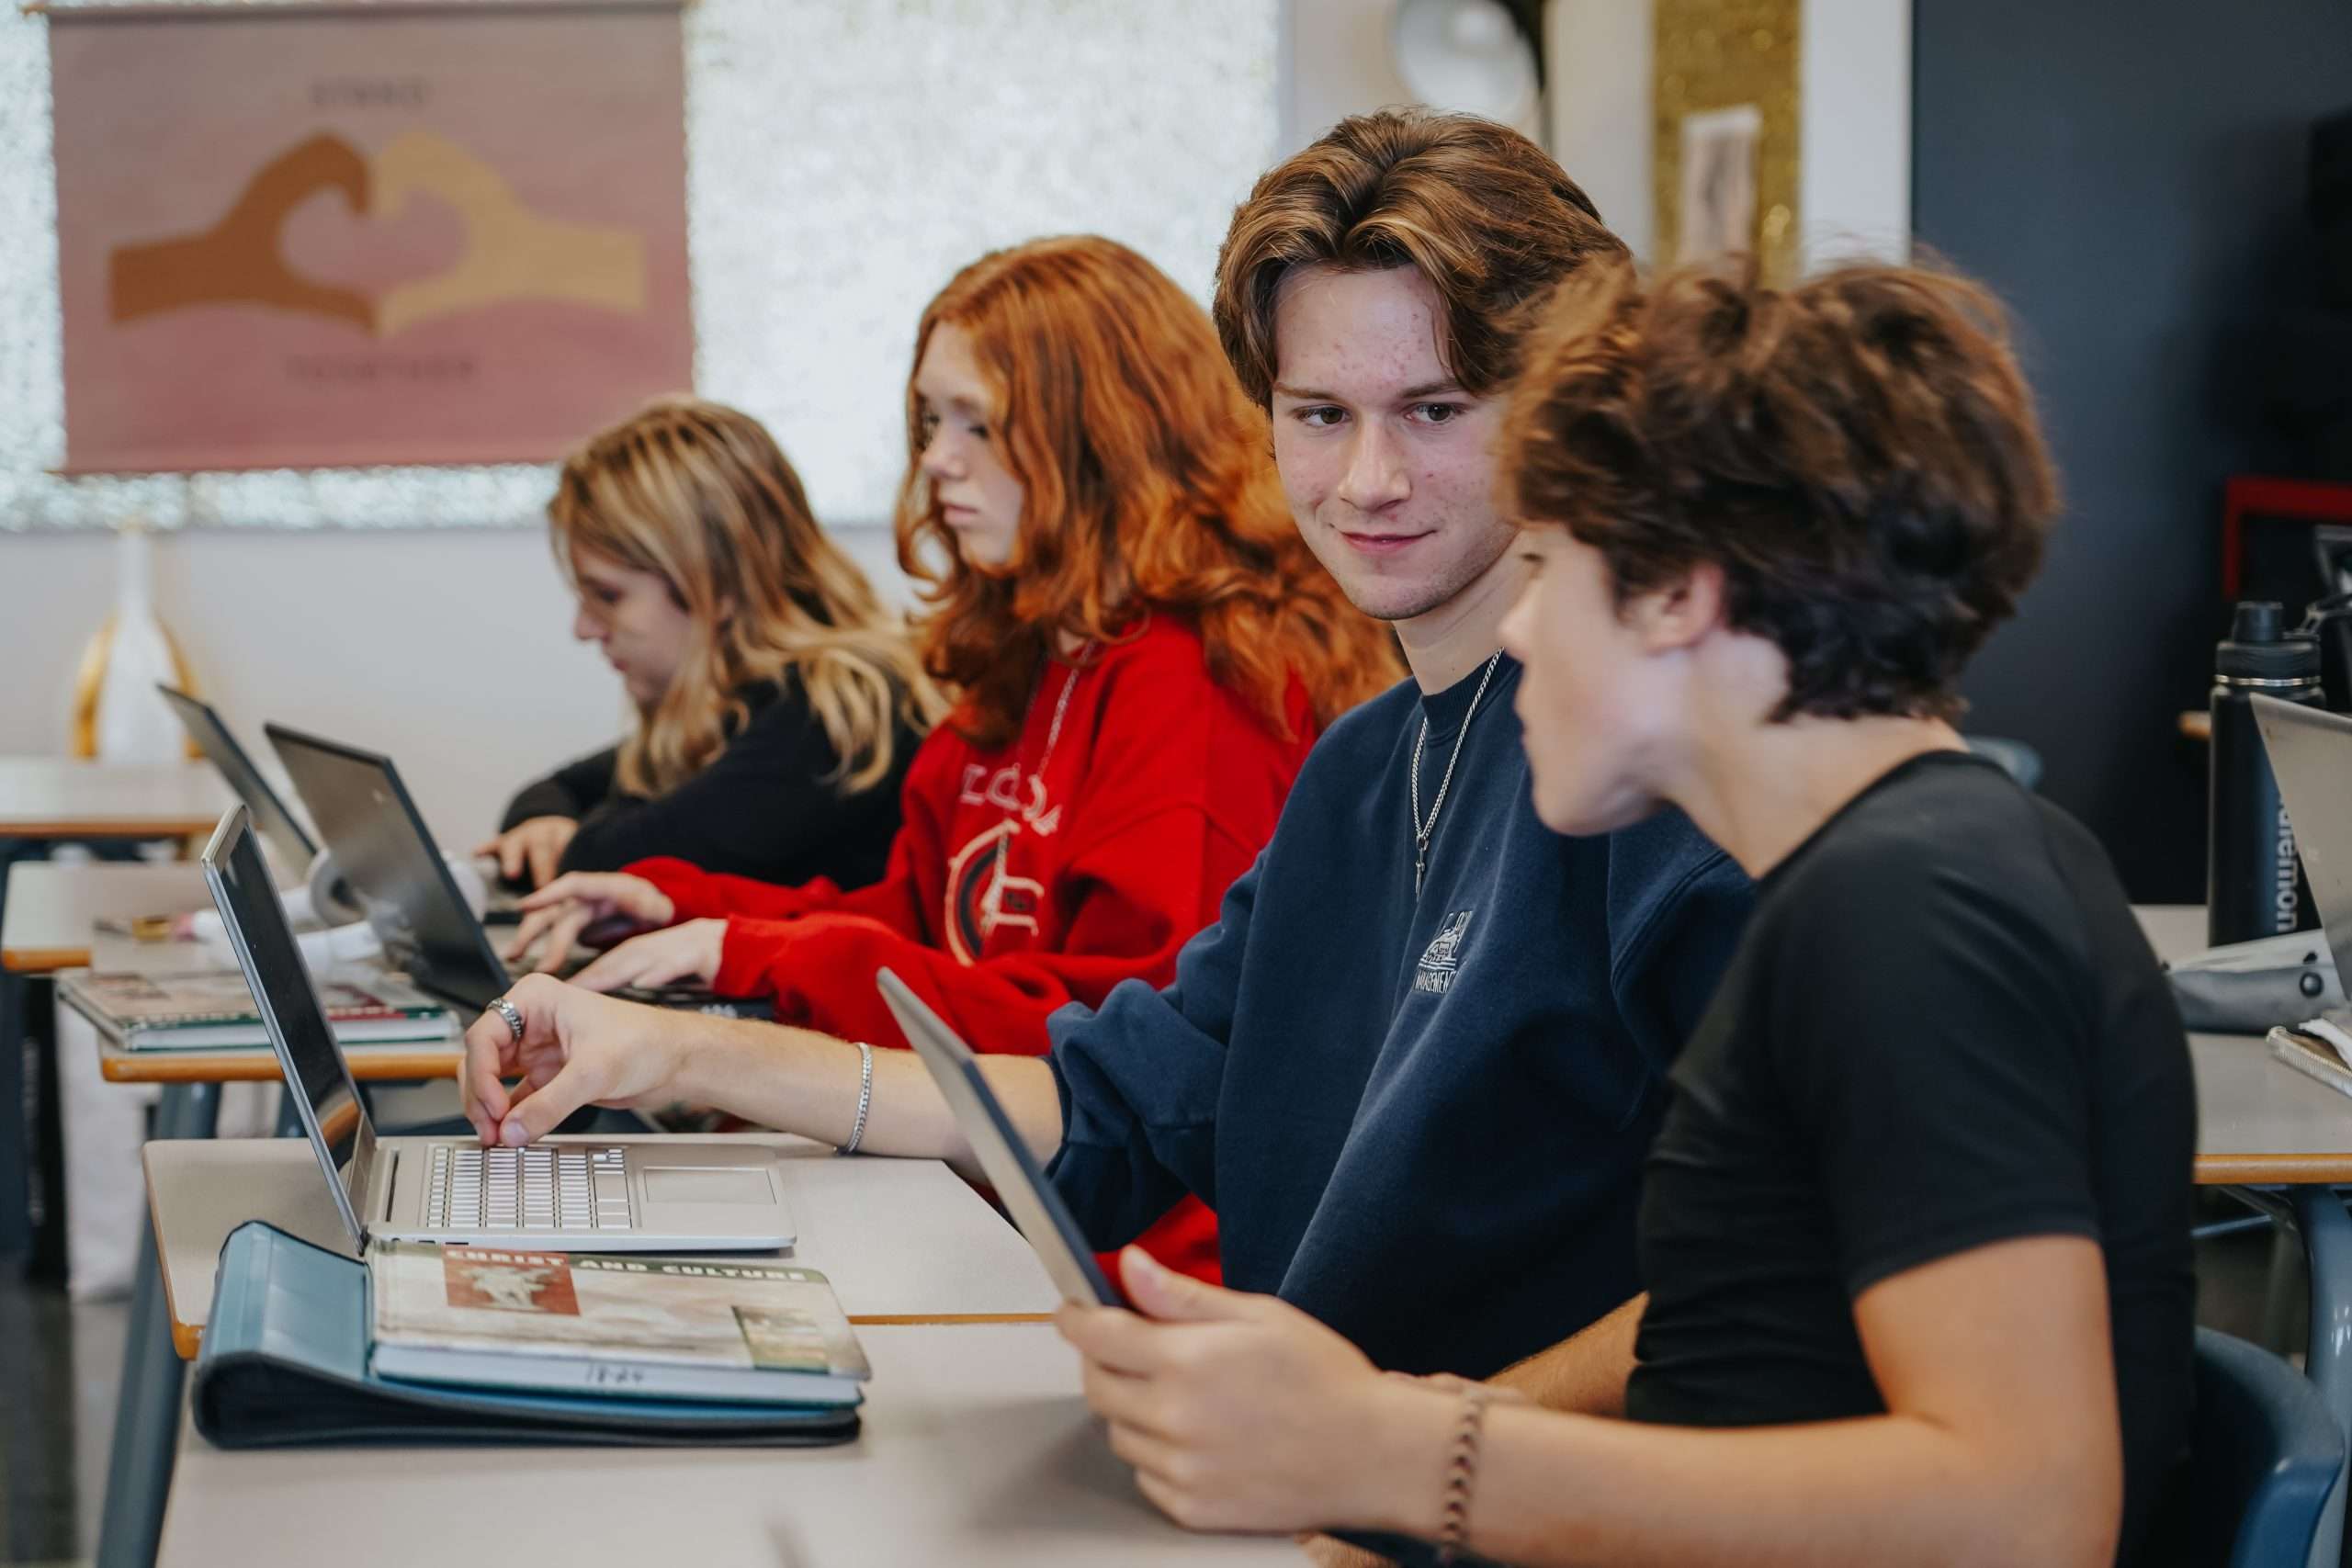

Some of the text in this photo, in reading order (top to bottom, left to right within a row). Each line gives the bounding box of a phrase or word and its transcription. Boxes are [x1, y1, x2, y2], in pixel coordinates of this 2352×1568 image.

[446, 1249, 807, 1282] CHRIST AND CULTURE
